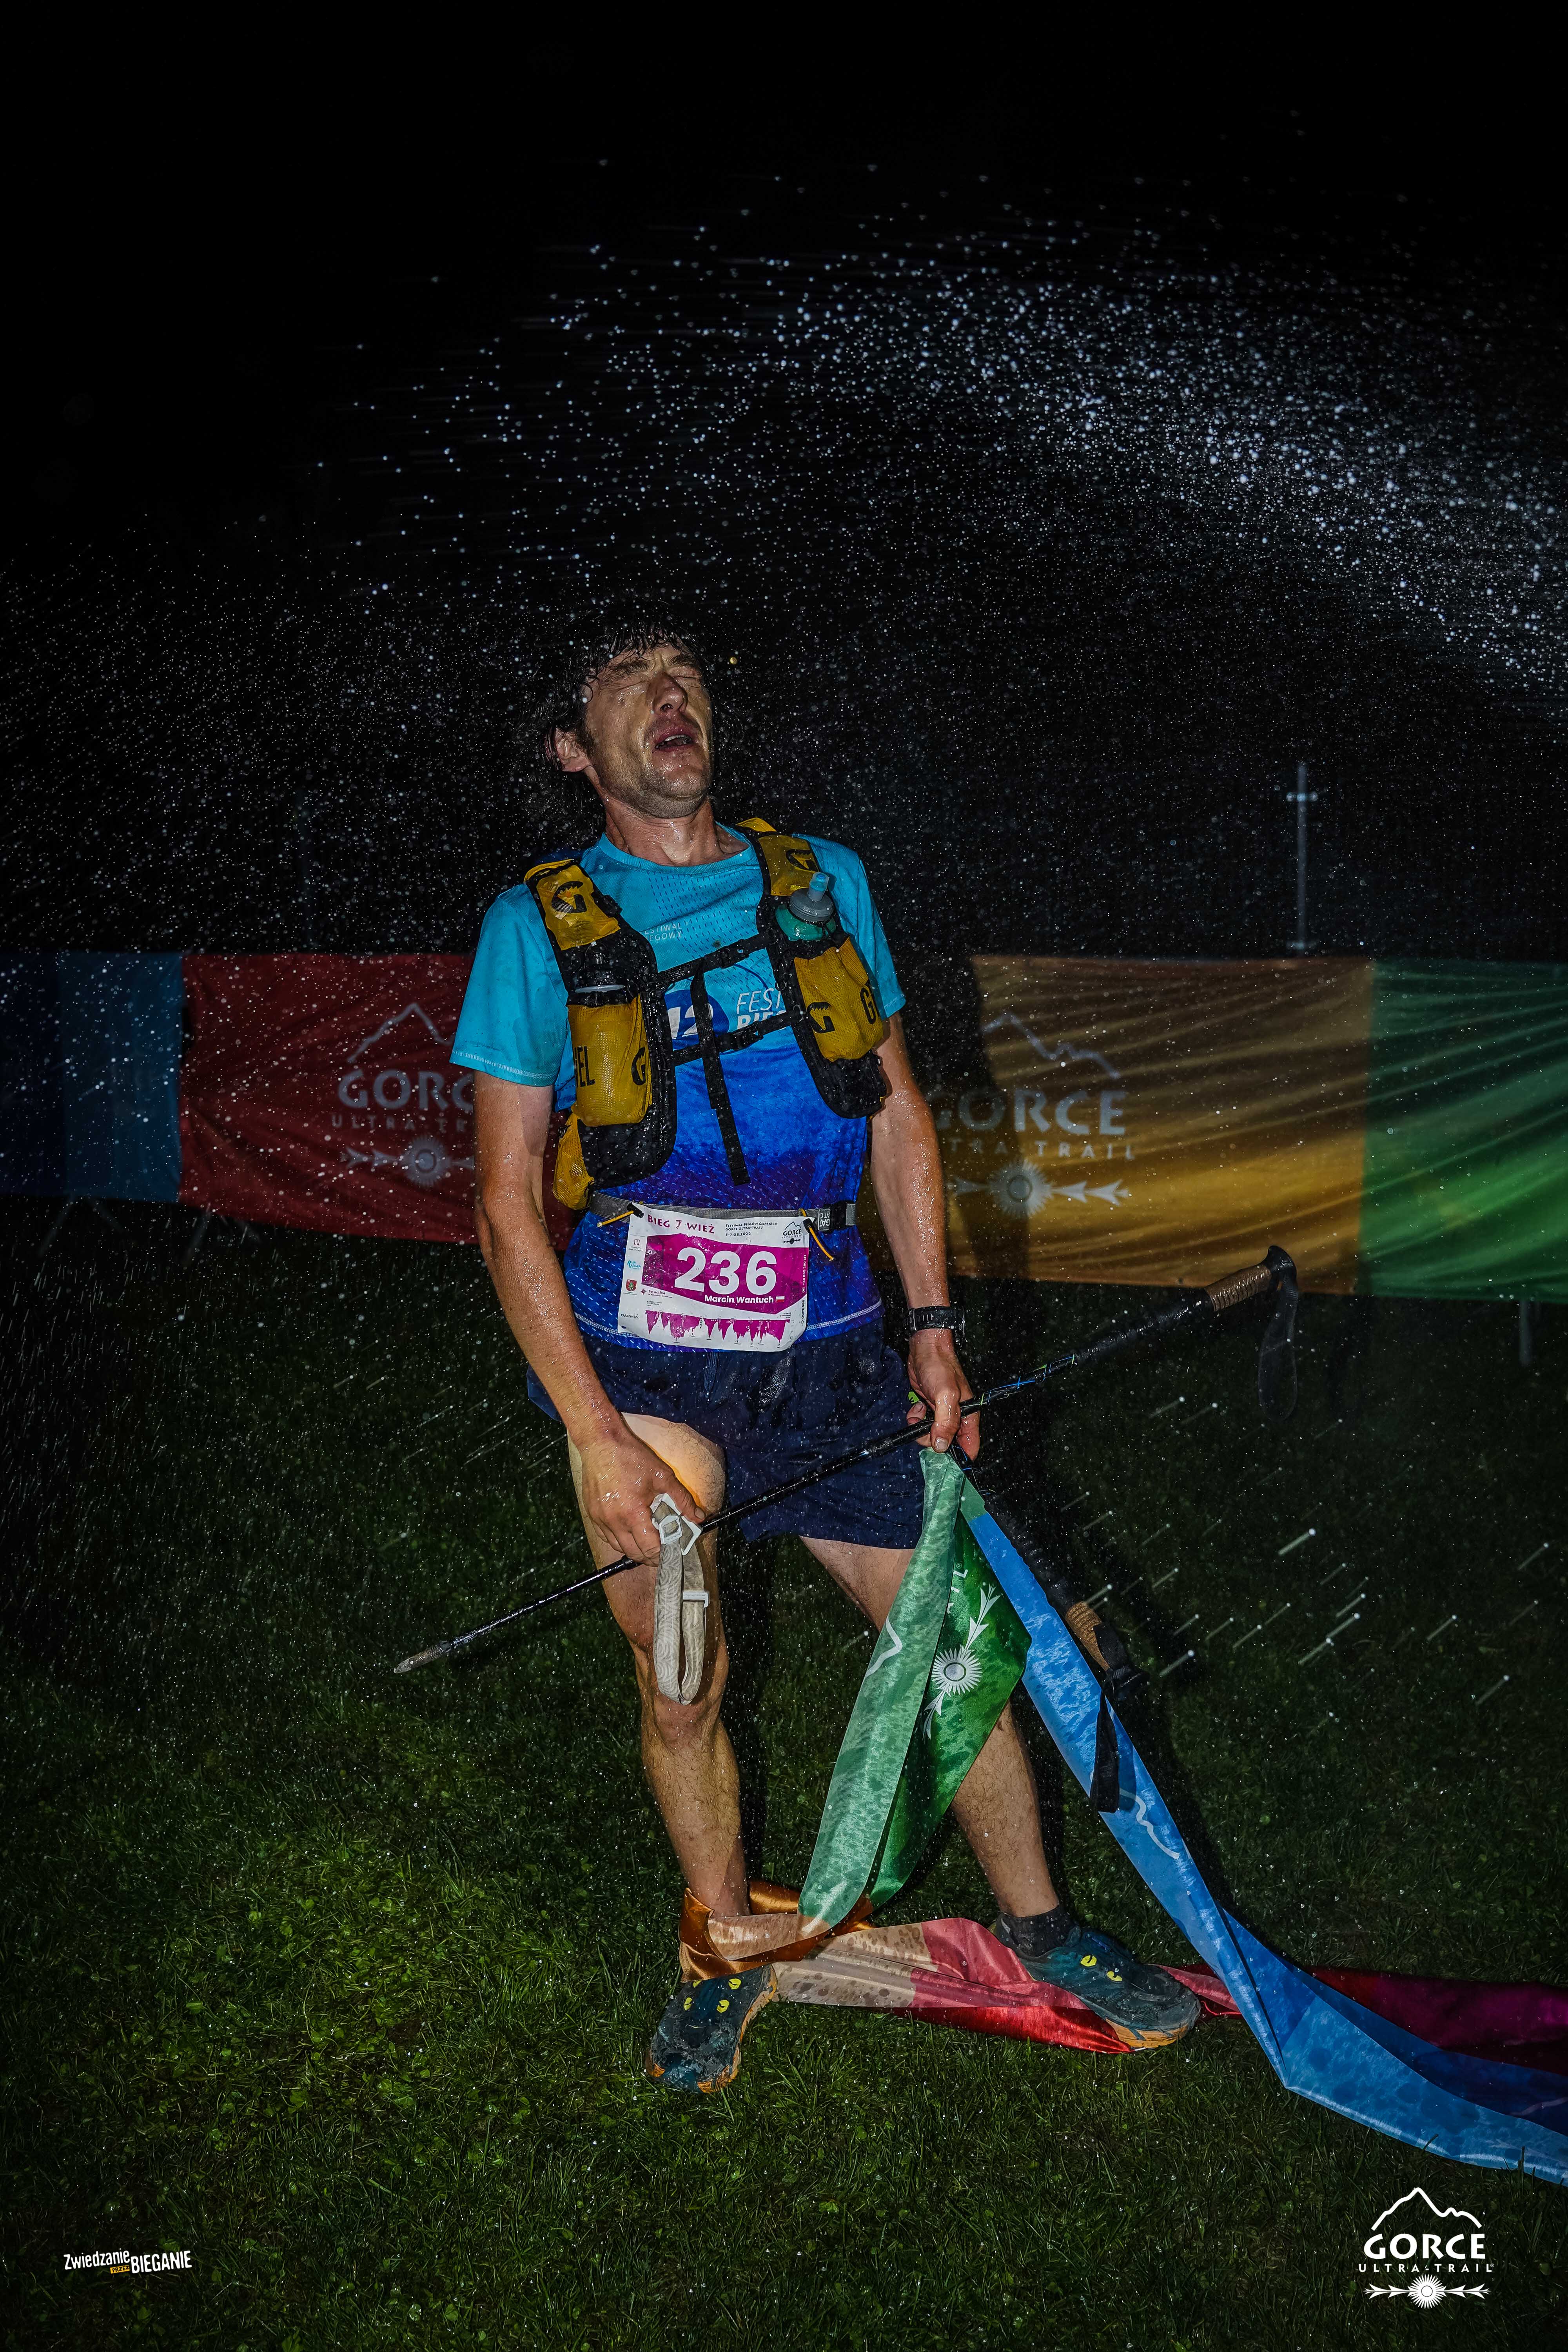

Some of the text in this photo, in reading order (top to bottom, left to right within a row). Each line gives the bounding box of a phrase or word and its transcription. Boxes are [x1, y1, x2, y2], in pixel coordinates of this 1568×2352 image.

[338, 1069, 474, 1113] GORC
[648, 1214, 715, 1234] BIEG 7 WIEŻ
[674, 1247, 777, 1295] 236
